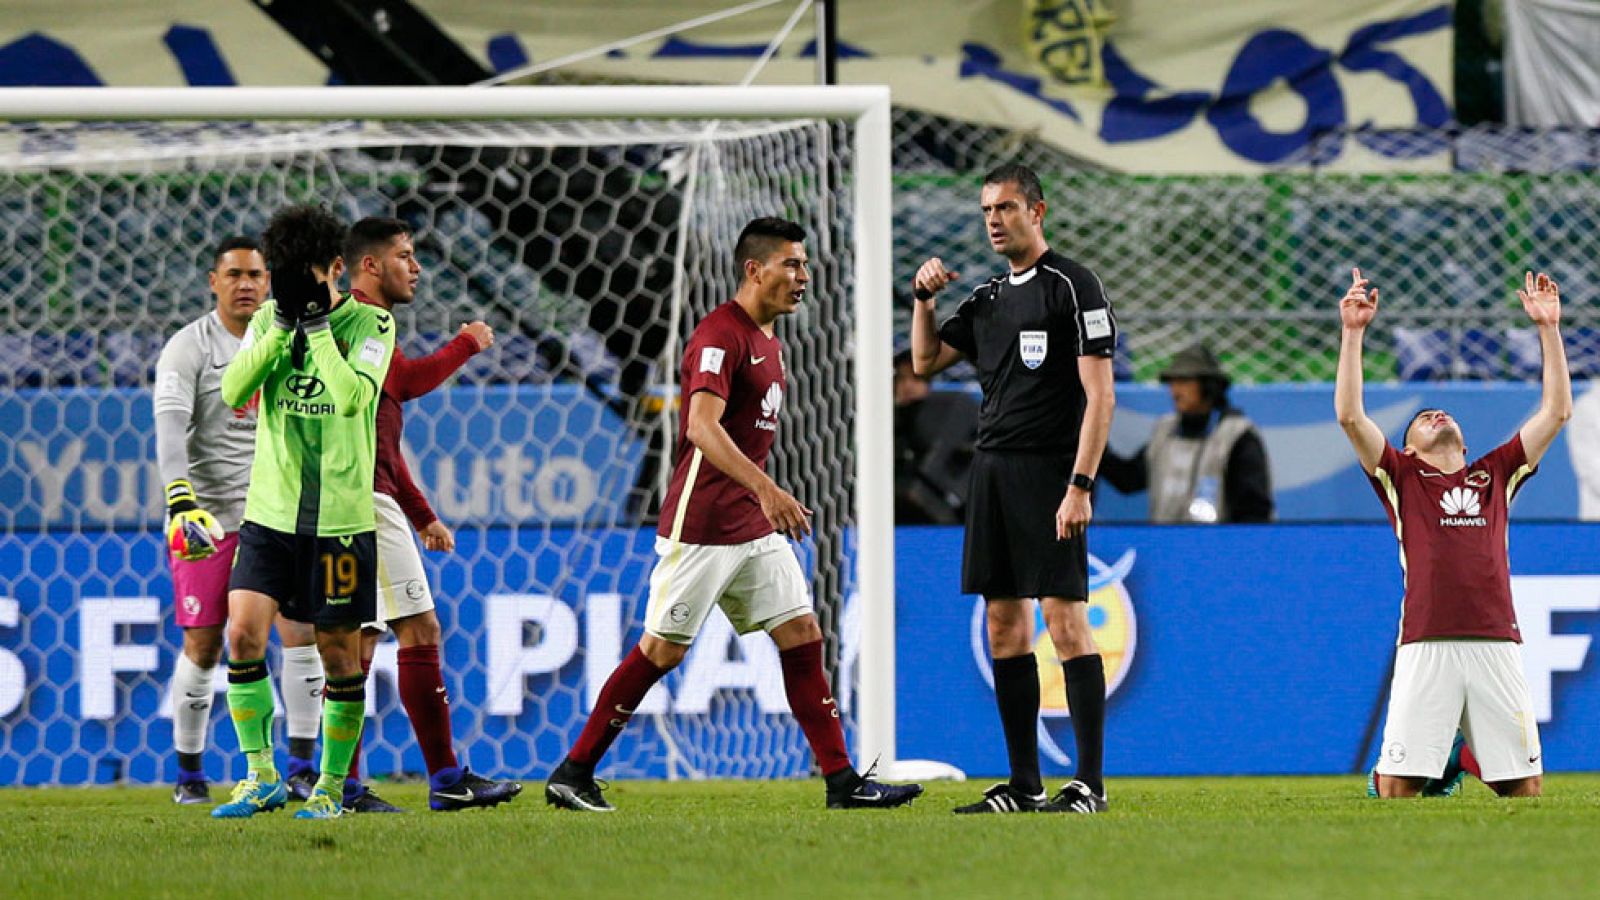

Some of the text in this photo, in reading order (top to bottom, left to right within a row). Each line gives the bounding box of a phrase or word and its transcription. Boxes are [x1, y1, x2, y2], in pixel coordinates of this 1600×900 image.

[1023, 344, 1044, 354] FIFA
[1439, 518, 1487, 527] HUAWEI
[320, 553, 358, 597] 19
